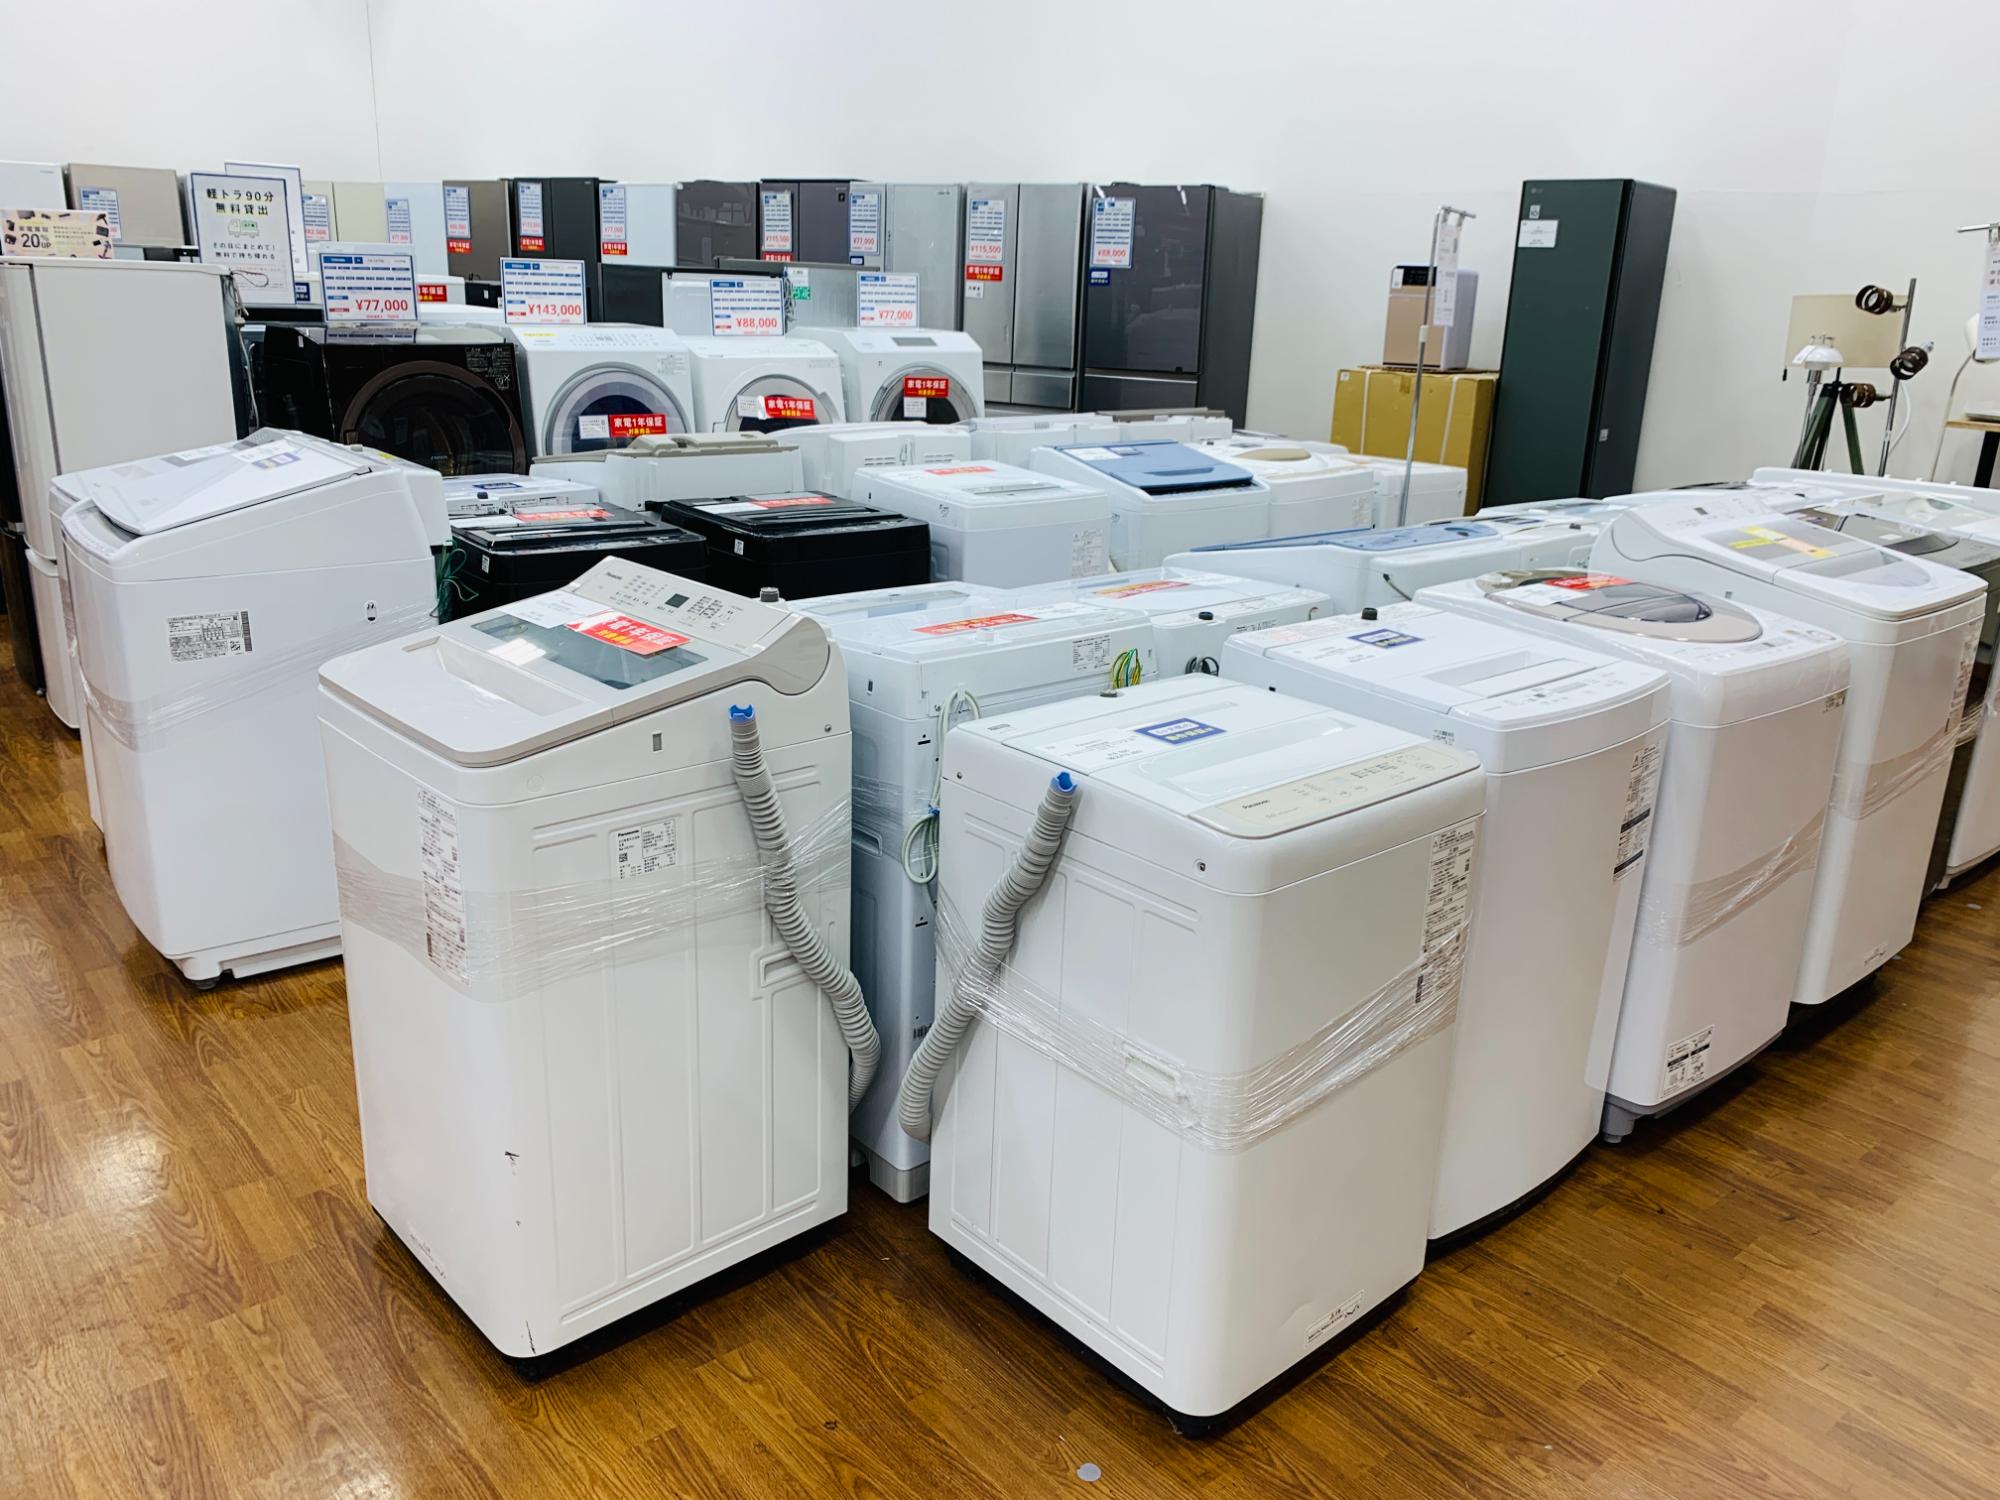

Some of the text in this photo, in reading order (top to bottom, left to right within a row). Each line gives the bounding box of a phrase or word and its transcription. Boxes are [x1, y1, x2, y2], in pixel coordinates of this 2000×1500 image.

[206, 188, 274, 203] 軽トラ90分
[215, 203, 269, 216] 無料貸出
[355, 299, 409, 312] ¥77,000
[528, 304, 582, 317] ¥143,000
[879, 310, 913, 321] ¥77,000
[736, 318, 778, 329] ¥88,000
[613, 416, 663, 428] 家電1年保証
